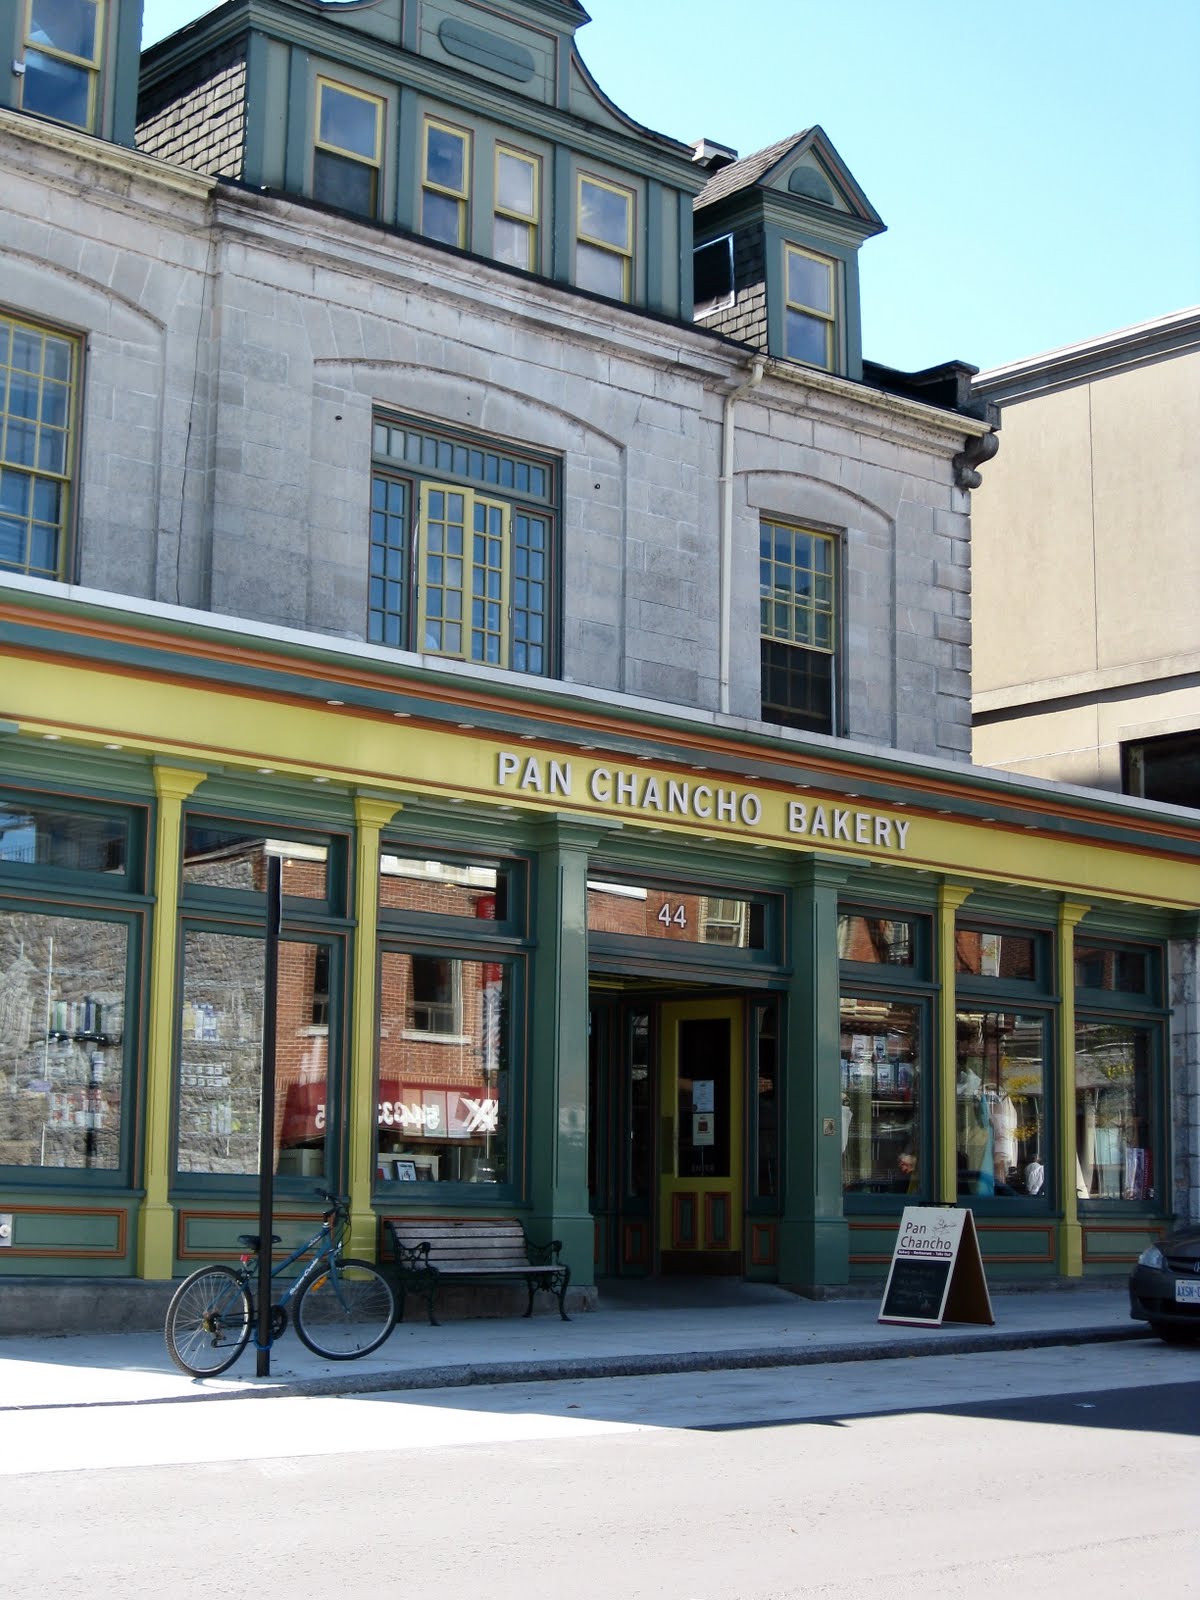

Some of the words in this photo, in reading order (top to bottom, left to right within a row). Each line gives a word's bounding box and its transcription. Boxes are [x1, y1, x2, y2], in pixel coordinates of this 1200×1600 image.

[498, 751, 572, 796] PAN
[591, 767, 763, 827] CHANCHO
[788, 801, 911, 850] BAKERY
[658, 903, 687, 928] 44
[905, 1221, 927, 1234] Pan
[900, 1235, 952, 1250] Chancho
